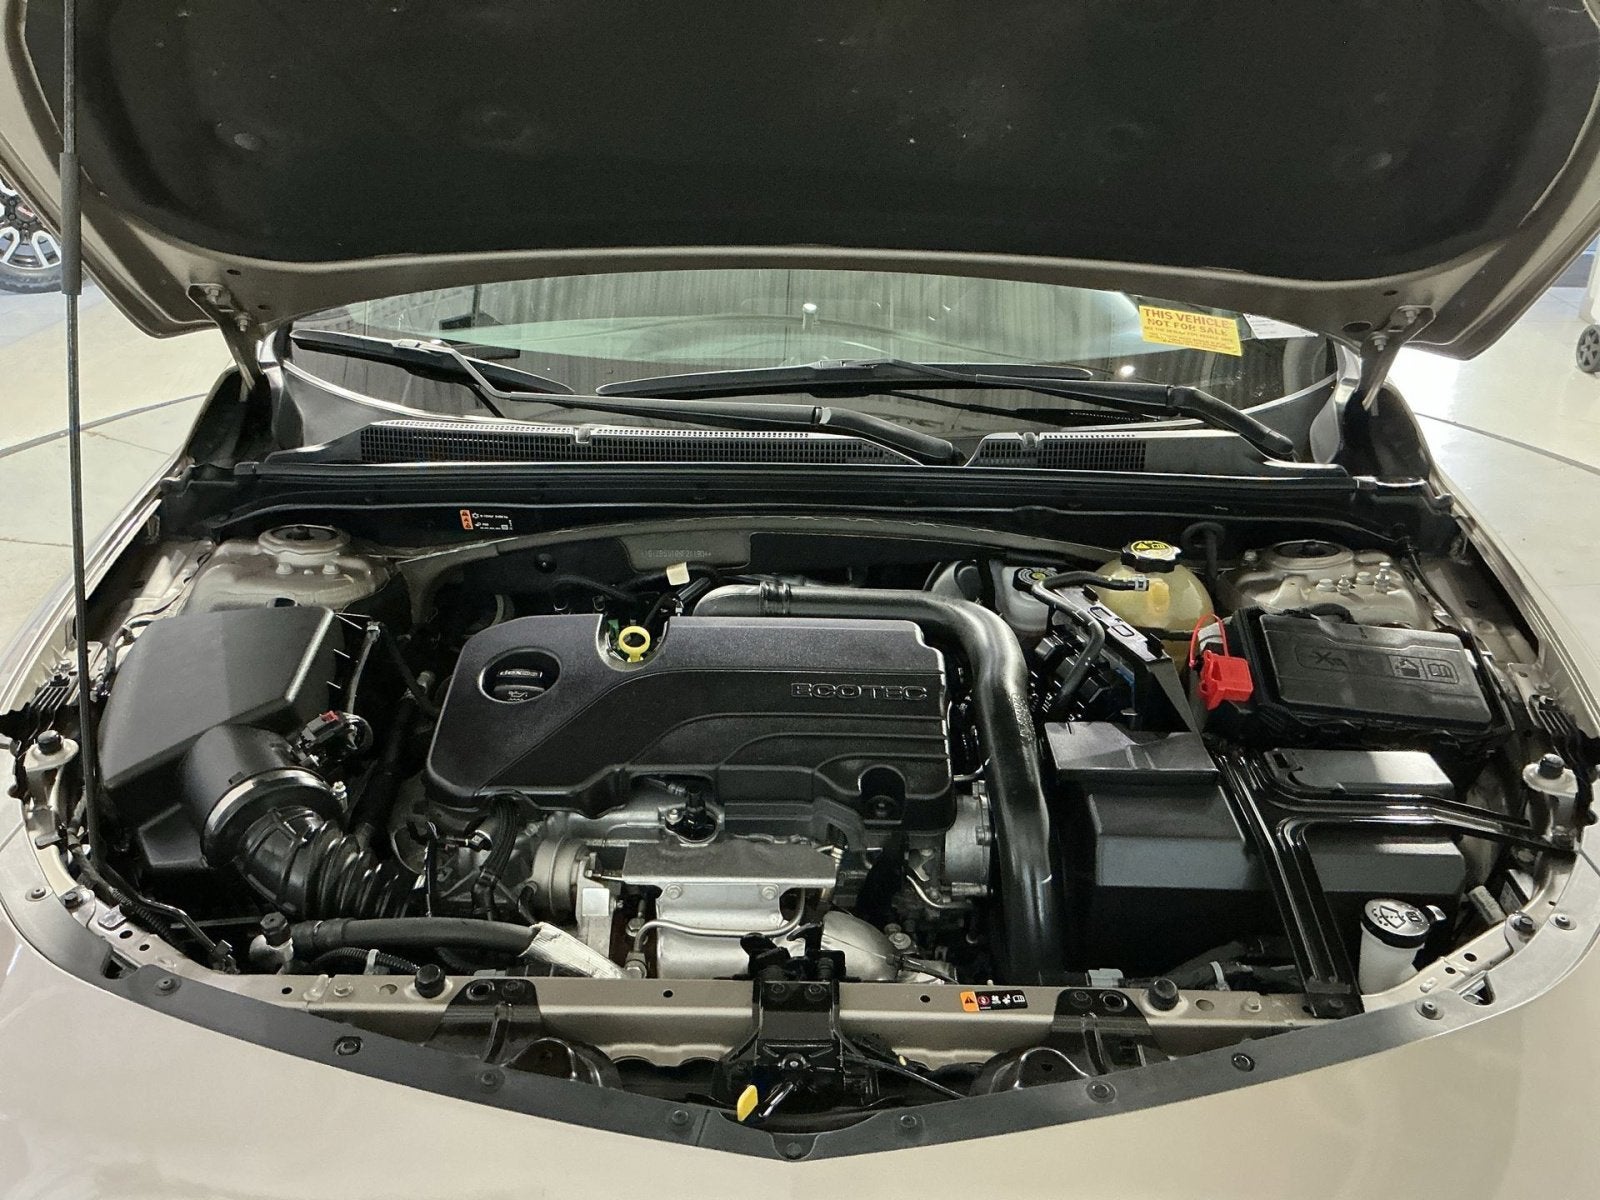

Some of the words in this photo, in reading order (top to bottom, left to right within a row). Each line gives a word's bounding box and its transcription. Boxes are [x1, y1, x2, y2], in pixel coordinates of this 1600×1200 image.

[1143, 308, 1173, 320] THIS
[1175, 313, 1230, 329] VEHICLE
[1147, 318, 1170, 327] NOT
[1173, 322, 1196, 332] FOR
[1199, 326, 1229, 336] SALE
[790, 682, 928, 700] ECOTEC
